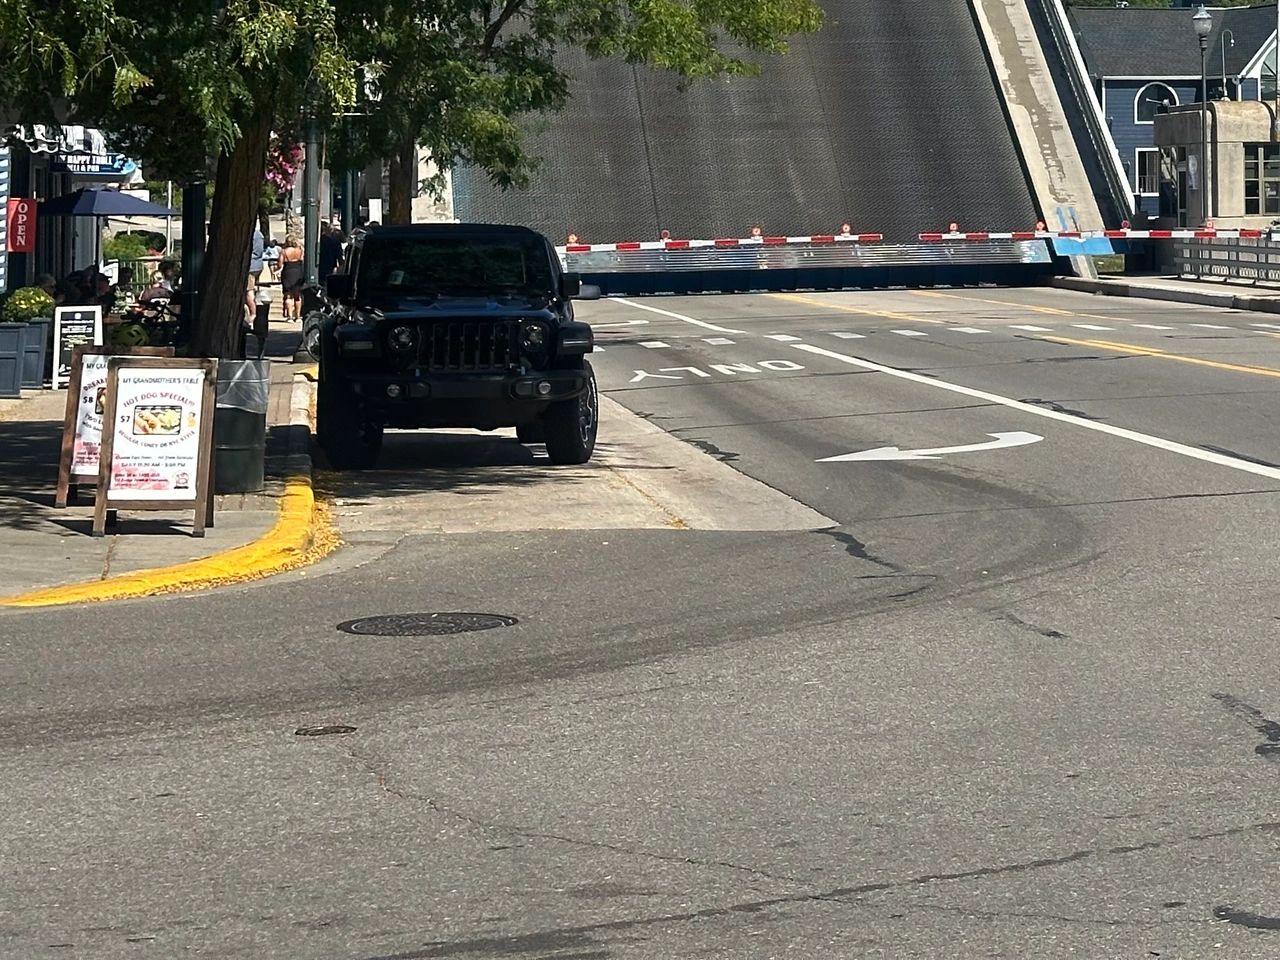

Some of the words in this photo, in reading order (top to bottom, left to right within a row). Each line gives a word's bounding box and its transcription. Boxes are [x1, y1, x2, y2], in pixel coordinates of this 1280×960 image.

[67, 155, 91, 164] HAPPY
[86, 164, 100, 172] PUB
[16, 202, 28, 246] OPEN
[628, 360, 806, 383] ONLY
[123, 396, 139, 408] HOT
[141, 392, 158, 400] DOG
[120, 415, 131, 423] $7
